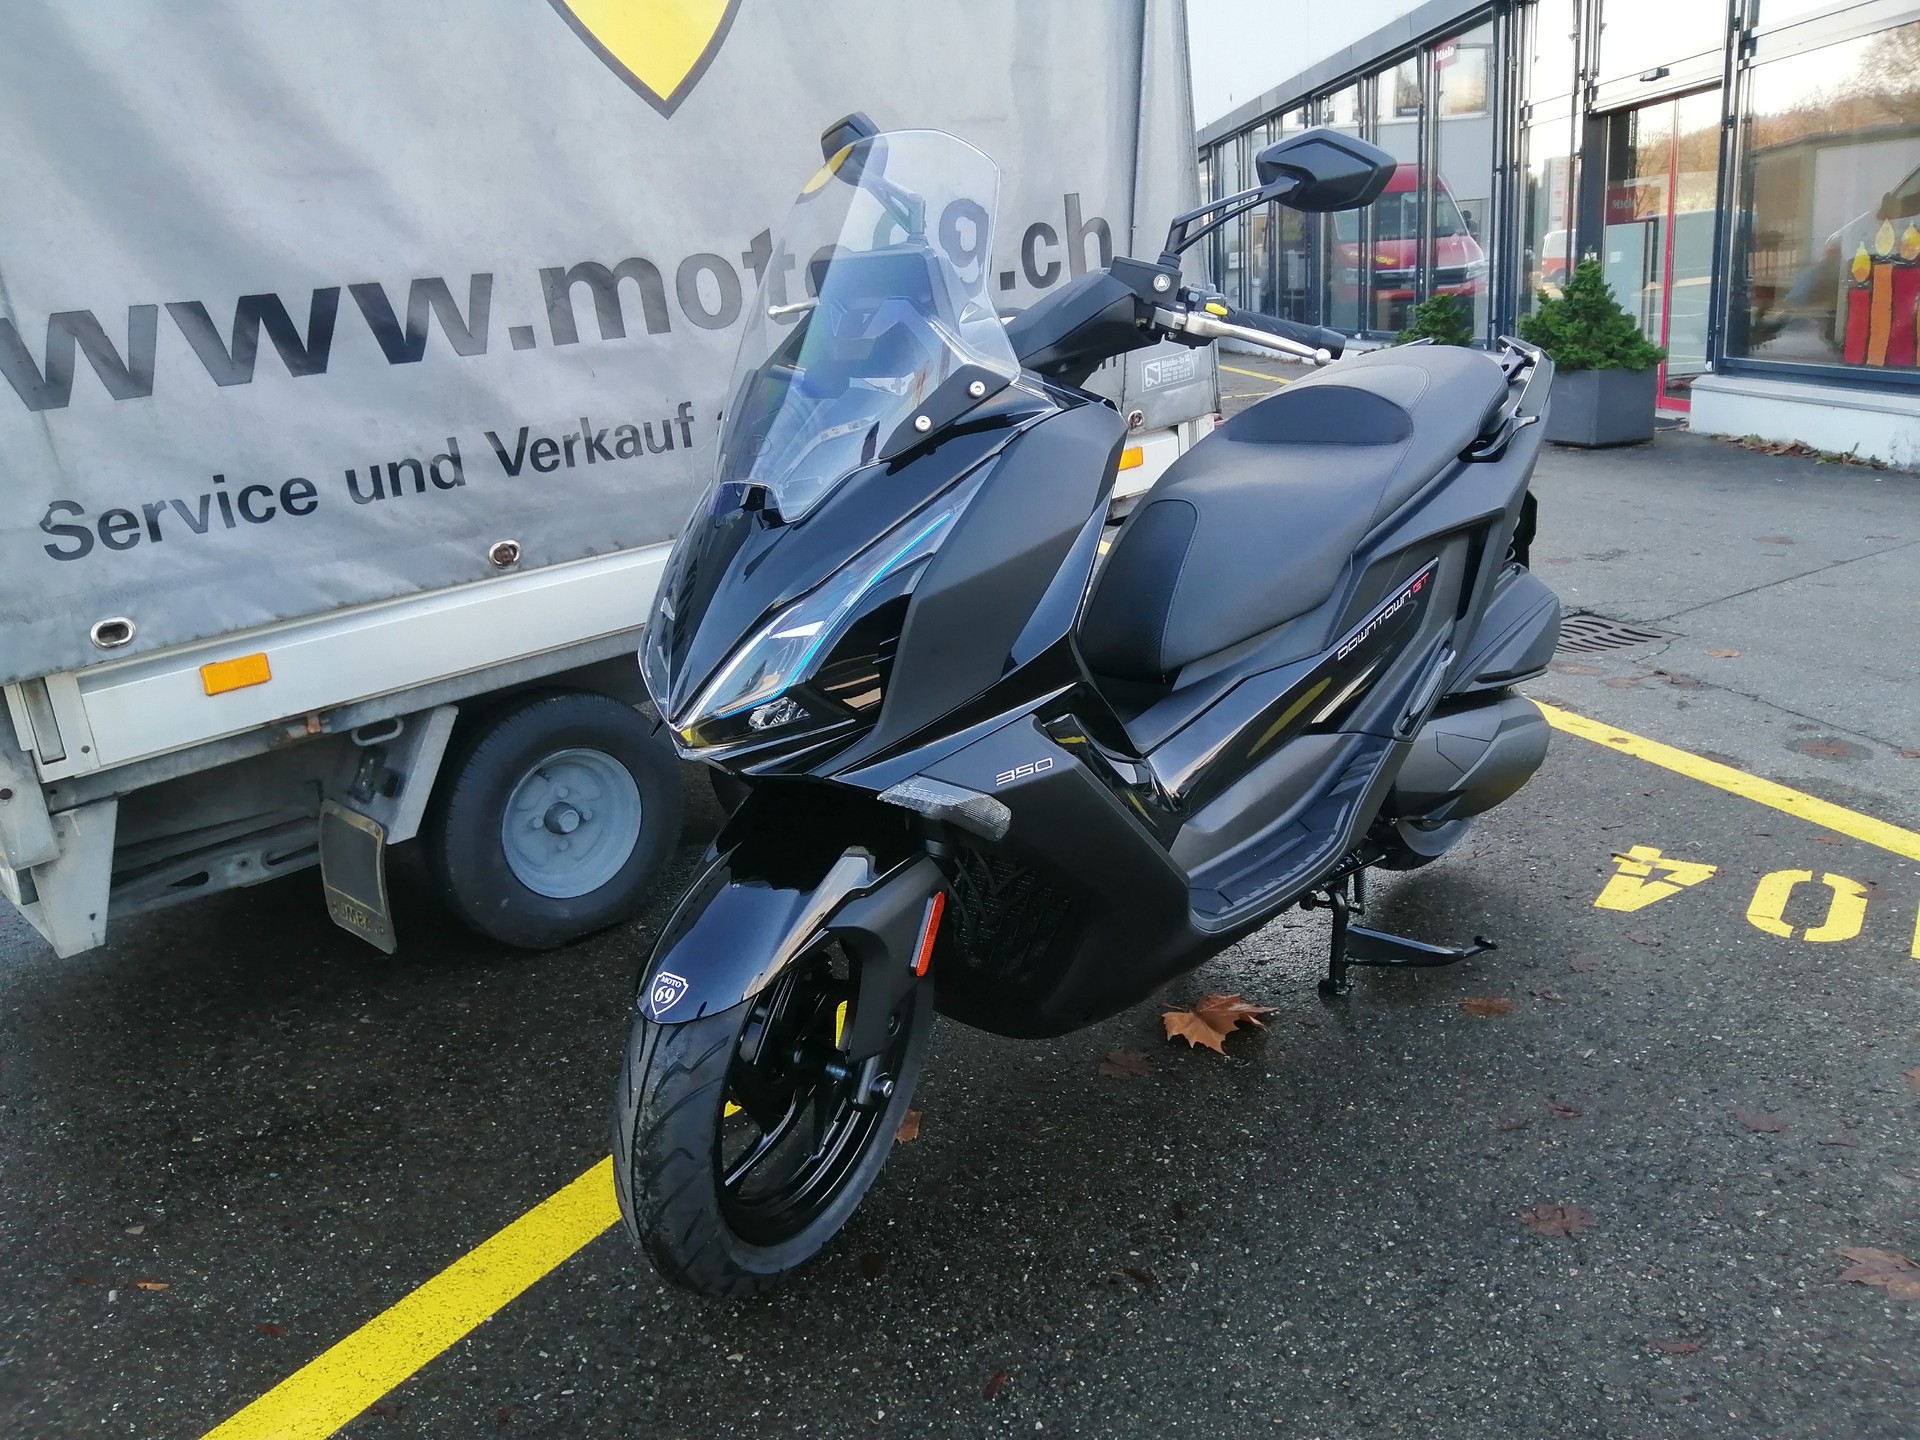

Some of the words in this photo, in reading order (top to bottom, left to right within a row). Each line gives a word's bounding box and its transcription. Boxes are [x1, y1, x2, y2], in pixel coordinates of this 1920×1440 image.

[0, 192, 1113, 412] www.mot9.ch
[40, 474, 318, 562] Service
[346, 437, 466, 505] und
[485, 401, 695, 478] Verkauf
[1412, 572, 1429, 594] GT
[995, 757, 1053, 787] 350
[1593, 845, 1920, 960] 04
[654, 985, 676, 1004] 69
[660, 975, 682, 988] MOTO
